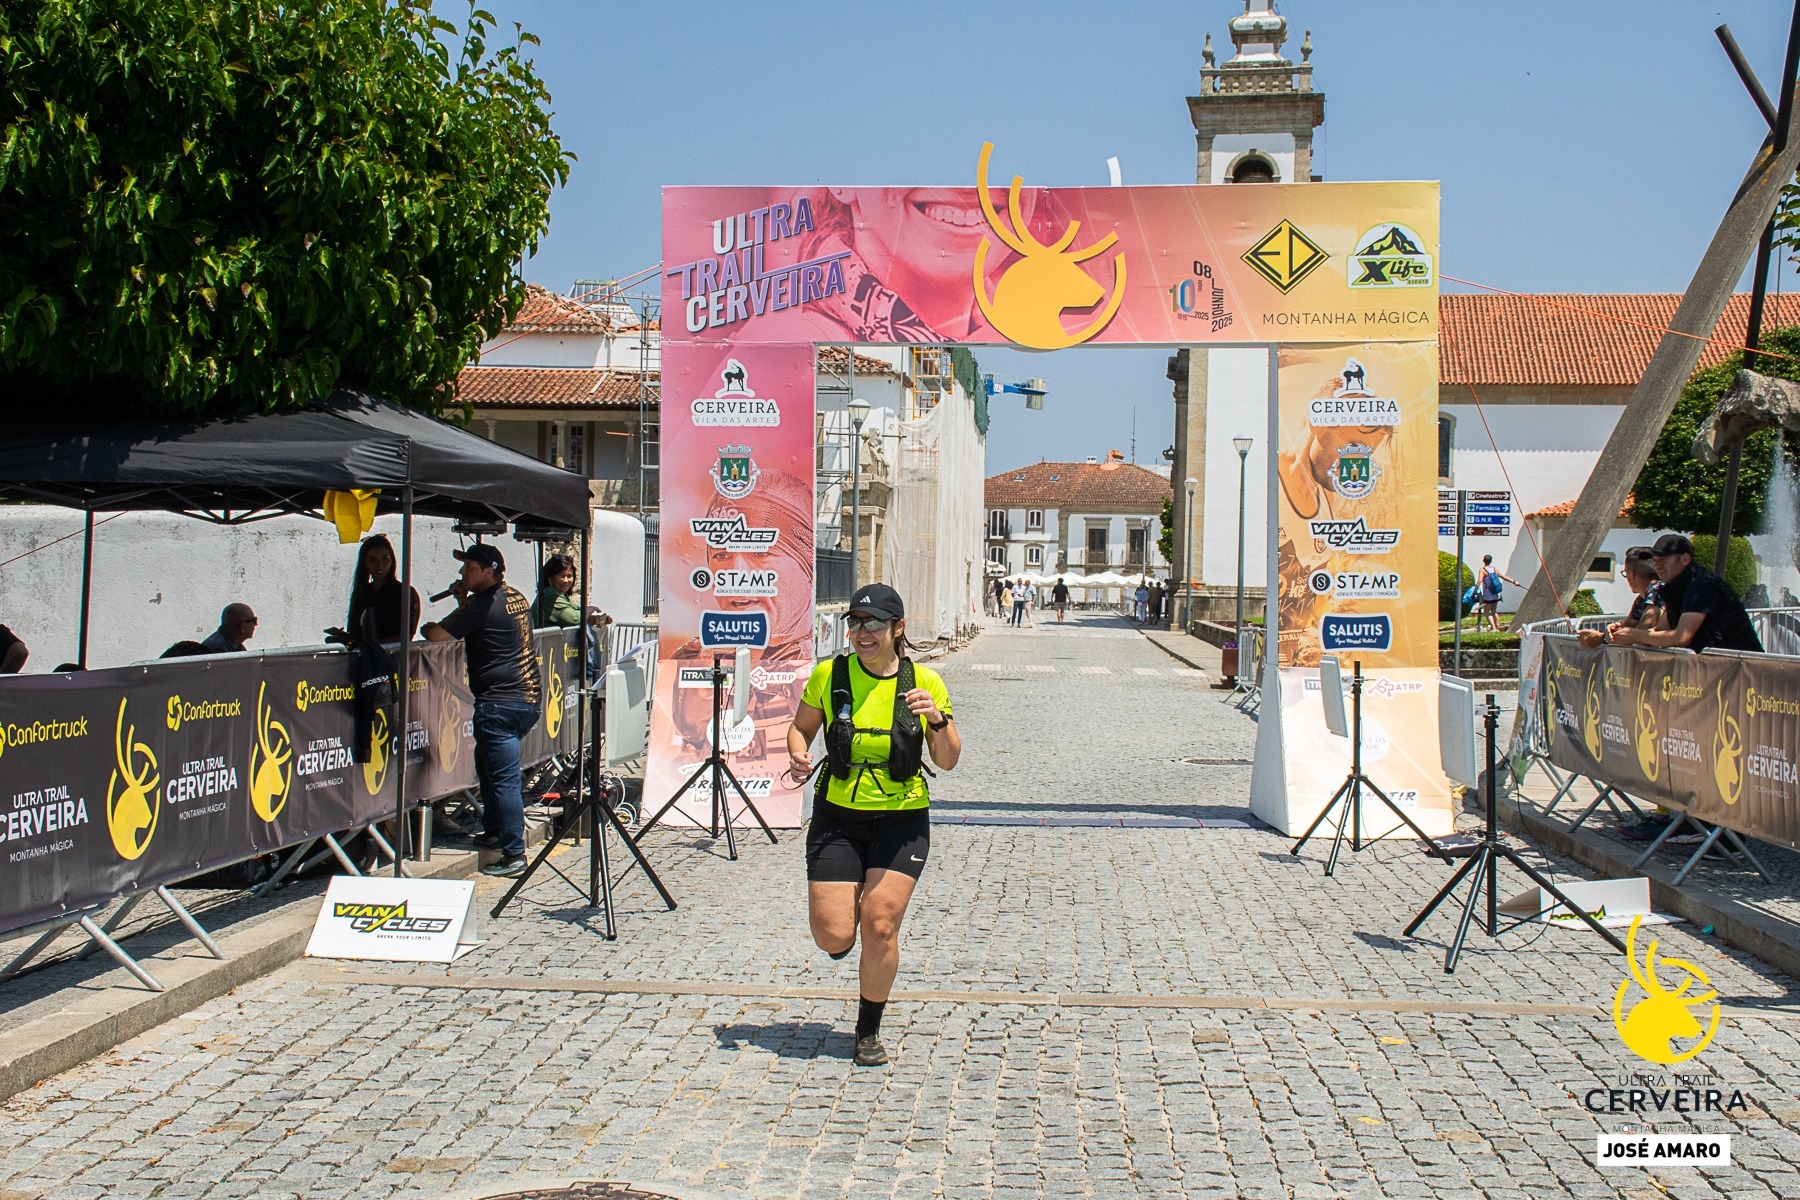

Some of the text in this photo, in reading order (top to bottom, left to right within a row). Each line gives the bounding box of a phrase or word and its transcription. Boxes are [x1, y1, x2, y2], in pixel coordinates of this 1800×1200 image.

[713, 197, 813, 254] ULTRA
[1194, 260, 1212, 278] 08
[686, 259, 845, 332] CERVEIRA
[1168, 279, 1195, 314] 10
[1212, 278, 1224, 317] JUNHO
[1195, 311, 1209, 320] 2025
[1212, 316, 1232, 332] 2025
[1263, 309, 1429, 325] MONTANHA MÁGICA
[694, 402, 776, 413] CERVEIRA
[1312, 401, 1398, 413] CERVEIRA
[693, 516, 744, 532] VIANA
[1312, 518, 1365, 534] VIANA
[710, 531, 776, 544] CYCLES
[1328, 532, 1398, 546] CYCLES
[717, 573, 776, 586] STAMP
[1337, 575, 1398, 588] STAMP
[708, 620, 760, 633] SALUTIS
[1329, 624, 1383, 636] SALUTIS
[310, 684, 355, 703] Confortruck
[1672, 682, 1703, 698] Confortruck
[184, 698, 241, 721] Confortruck
[1757, 695, 1800, 715] Confortruck
[8, 716, 88, 747] Confortruck
[1602, 723, 1630, 746] CERVEIRA
[308, 736, 342, 751] ULTRA TRAIL
[1662, 737, 1702, 762] CERVEIRA
[1757, 744, 1787, 760] ULTRA TRAIL
[182, 756, 226, 775] ULTRA TRAIL
[297, 746, 354, 776] CERVEIRA
[1747, 754, 1798, 785] CERVEIRA
[167, 767, 238, 804] CERVEIRA
[14, 785, 70, 808] ULTRA TRAIL
[179, 802, 227, 820] MONTANHA MÁGICA
[10, 839, 73, 863] MONTANHA MÁGICA
[334, 900, 408, 918] VIANA
[351, 917, 452, 933] CYCLES
